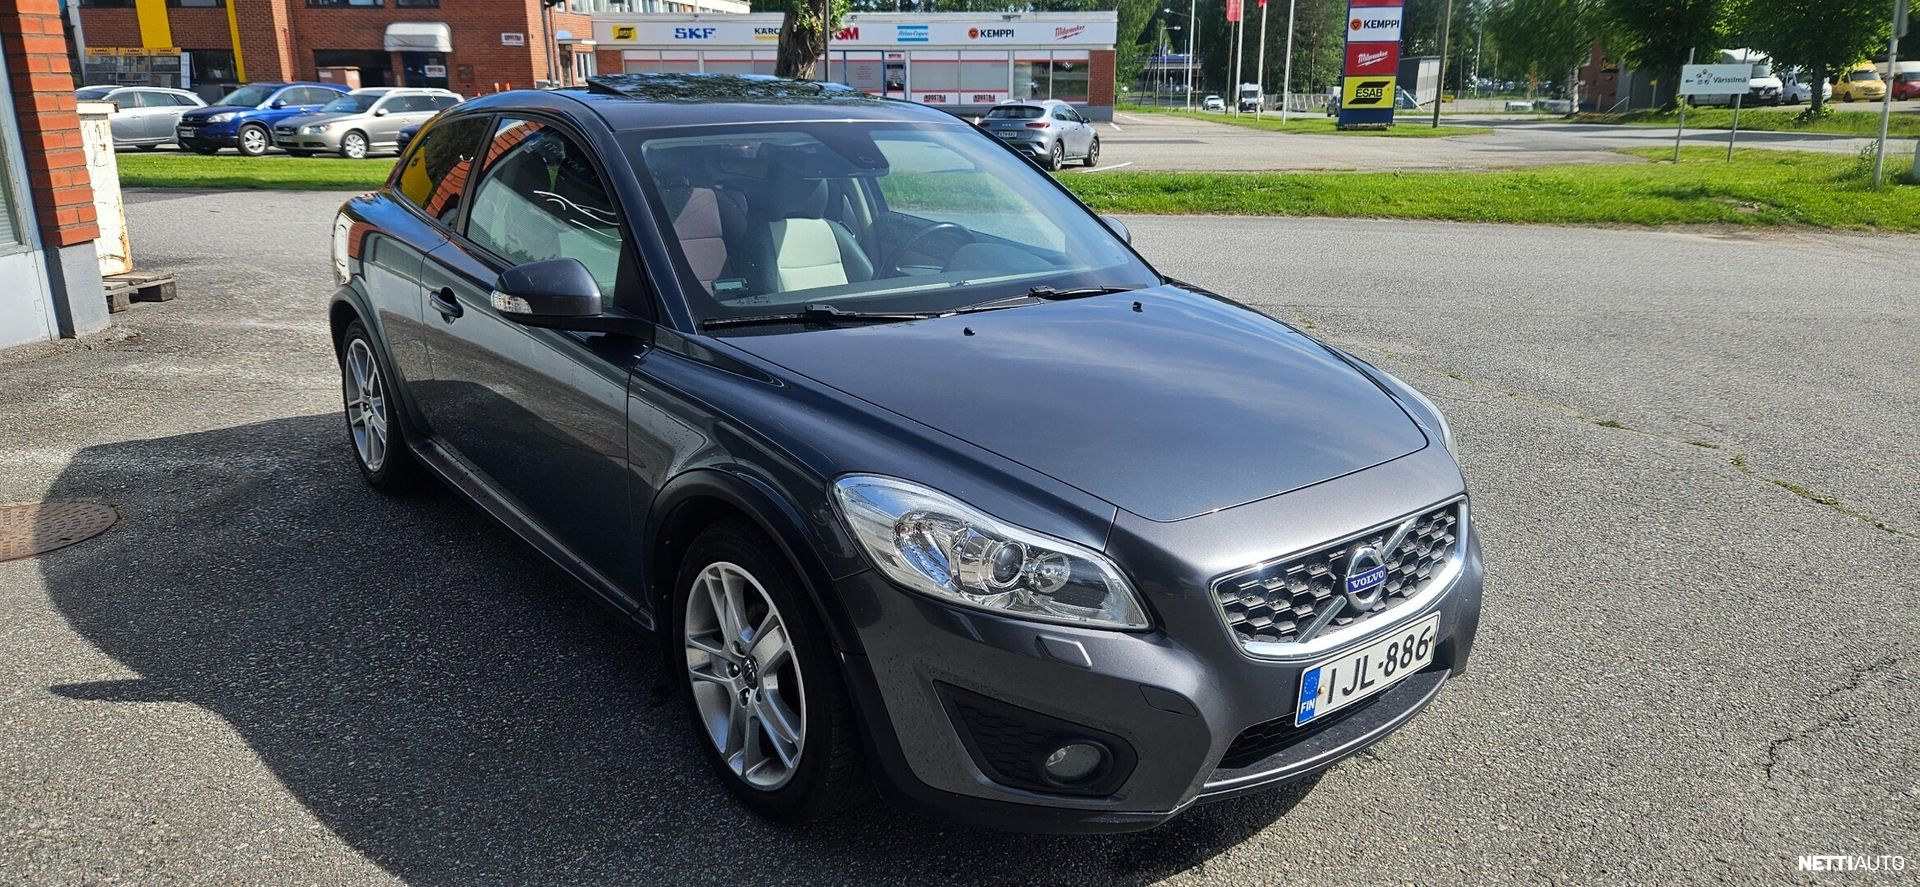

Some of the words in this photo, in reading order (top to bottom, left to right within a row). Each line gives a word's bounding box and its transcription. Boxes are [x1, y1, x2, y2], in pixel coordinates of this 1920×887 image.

[1363, 19, 1400, 29] KEMPPI
[674, 27, 716, 39] SKF
[980, 29, 1014, 38] KEMPPI
[1355, 88, 1383, 98] ESAB
[1351, 570, 1384, 588] VOLVO
[1327, 625, 1431, 705] IJL-886
[1300, 698, 1315, 714] FIN
